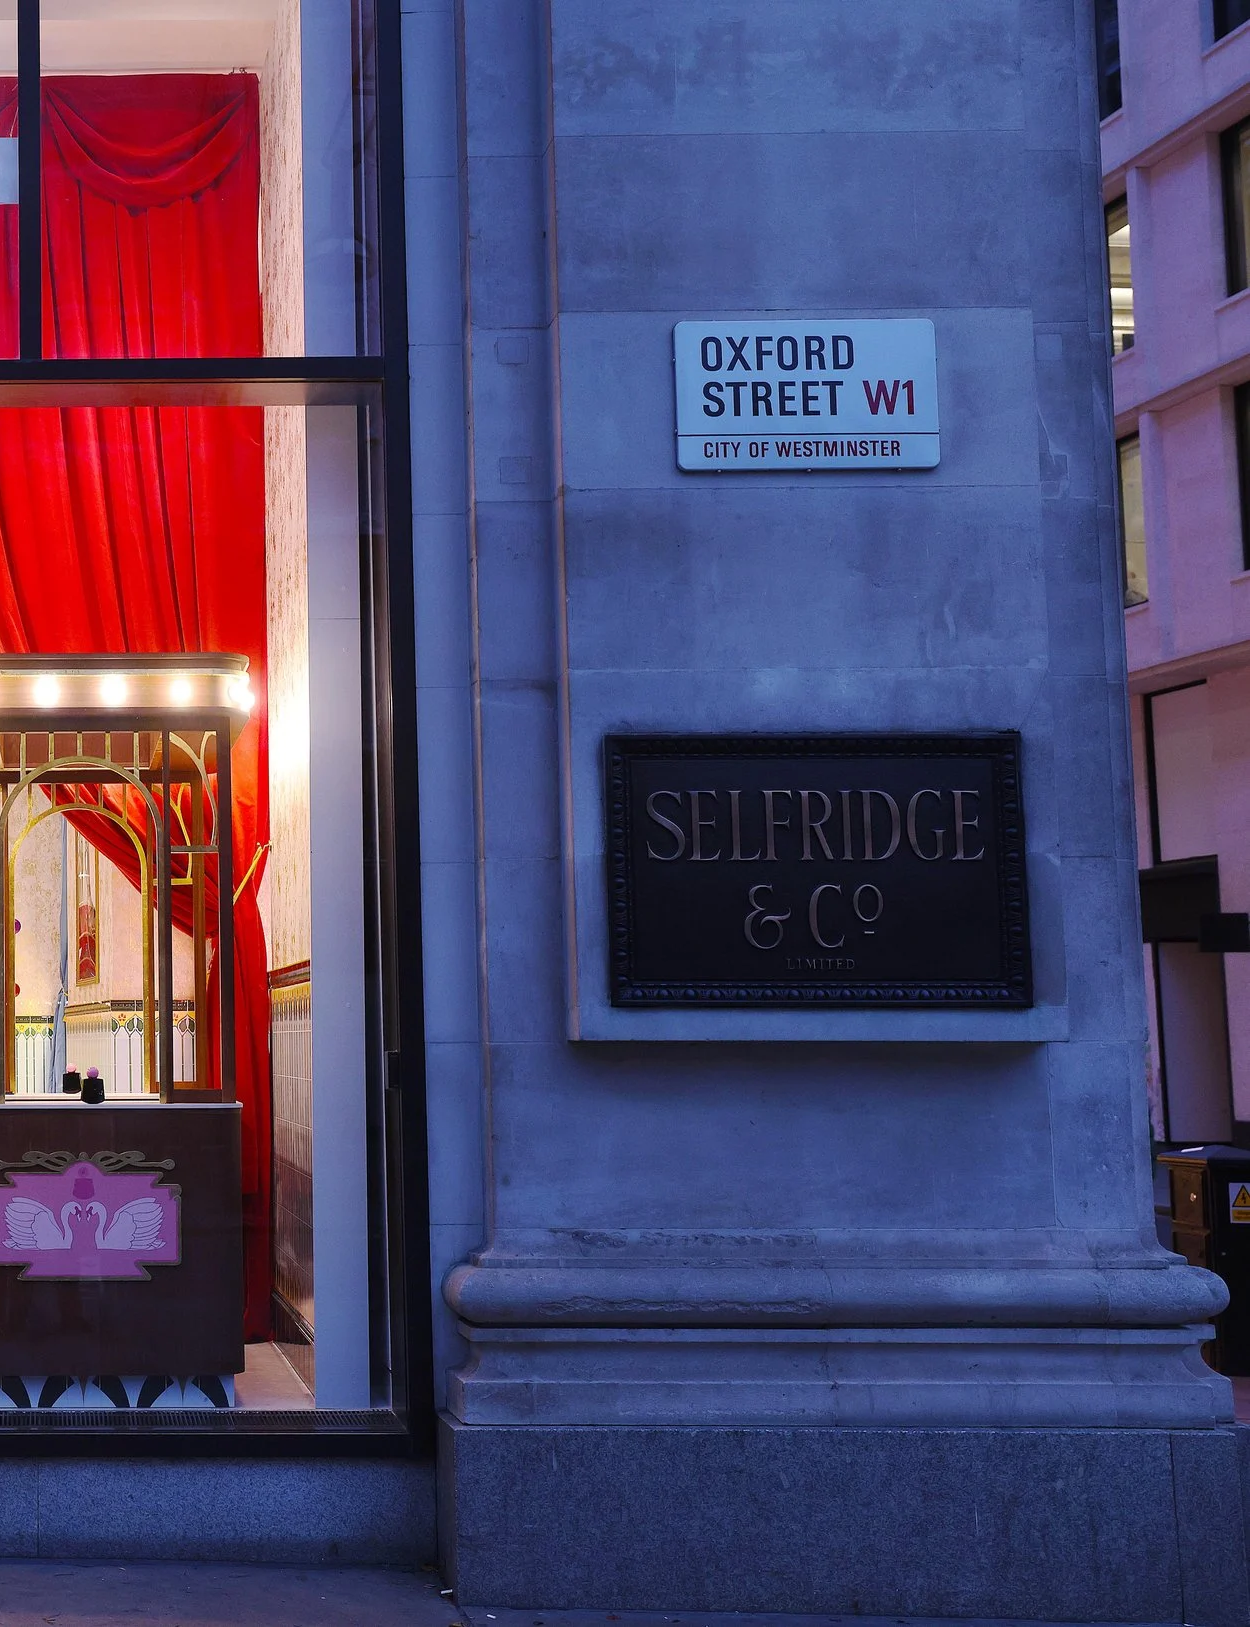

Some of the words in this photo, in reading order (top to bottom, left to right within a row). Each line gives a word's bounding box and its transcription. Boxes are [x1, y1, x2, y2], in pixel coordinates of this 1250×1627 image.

[700, 335, 855, 372] OXFORD
[702, 380, 844, 417] STREET
[862, 379, 916, 416] W1
[703, 441, 741, 458] CITY
[749, 441, 769, 458] OF
[775, 440, 901, 457] WESTMINSTER
[646, 788, 986, 862] SELFRIDGE
[743, 884, 792, 950] &
[785, 957, 856, 971] LIMITED
